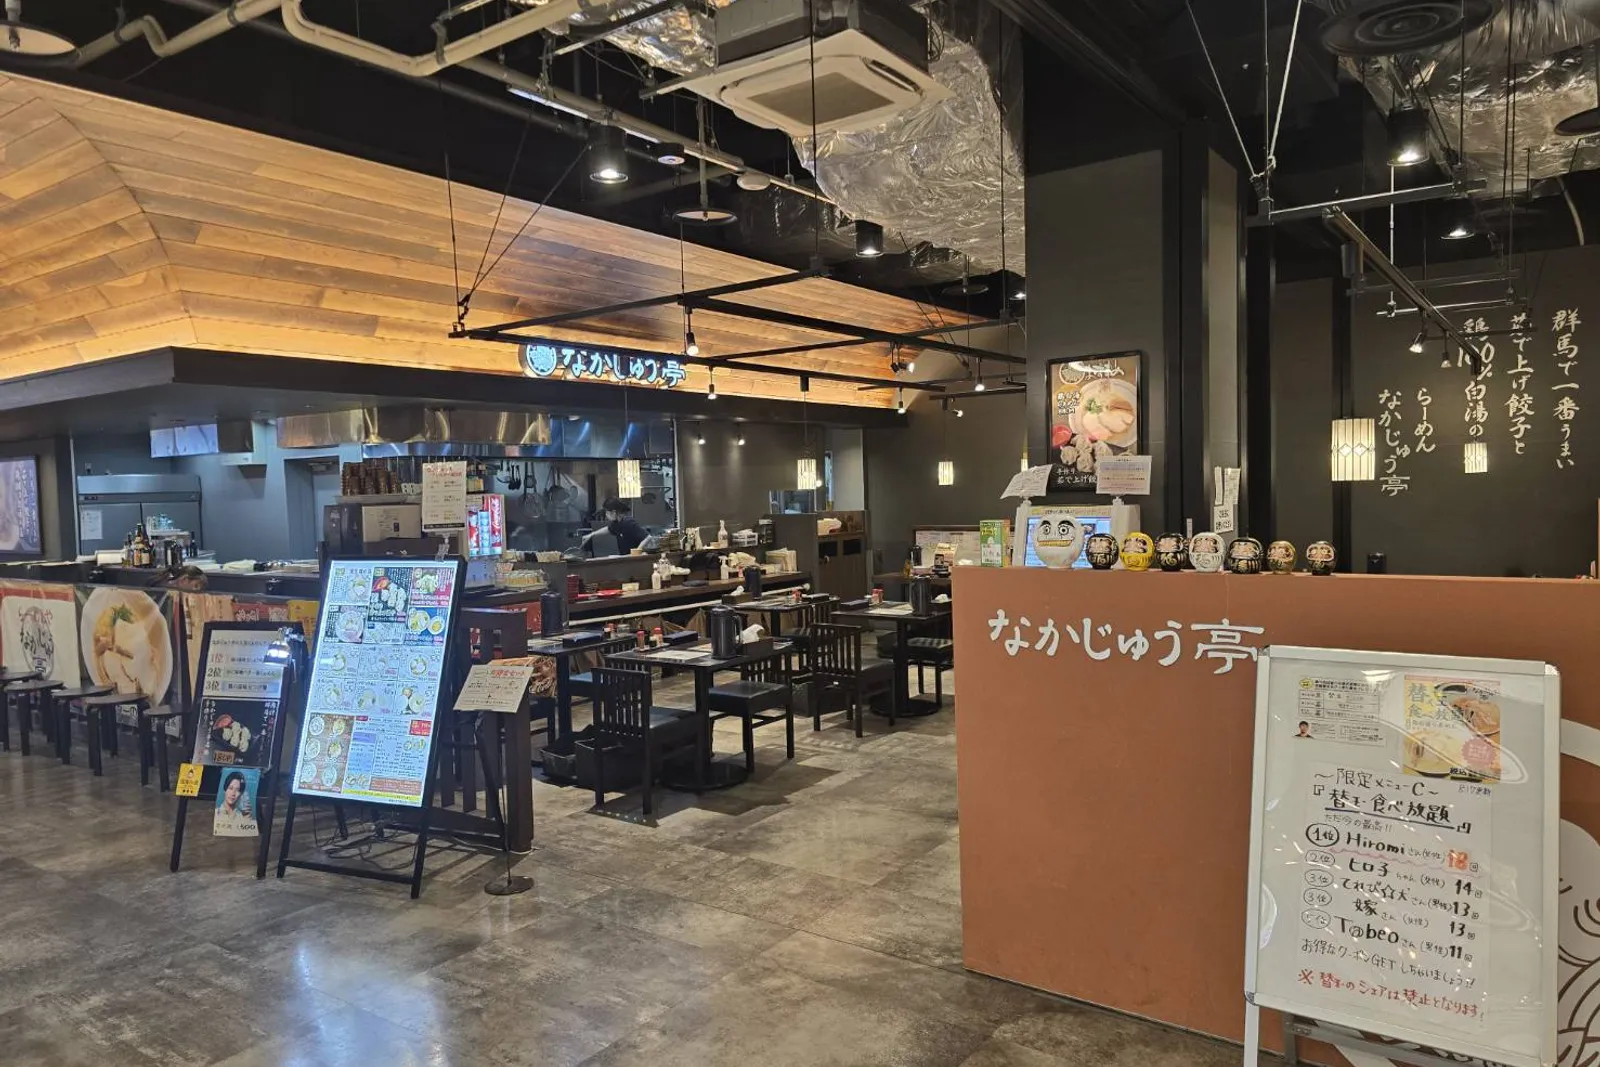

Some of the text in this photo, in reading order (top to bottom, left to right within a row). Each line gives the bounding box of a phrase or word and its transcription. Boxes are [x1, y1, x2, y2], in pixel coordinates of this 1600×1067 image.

[1413, 387, 1436, 453] らーめん
[1551, 308, 1582, 469] 群馬で一番うまい
[1378, 389, 1411, 497] なかじゅう亭
[988, 608, 1265, 675] なかじゅう亭
[1346, 831, 1406, 855] Hiromi
[1333, 915, 1399, 944] T@beo
